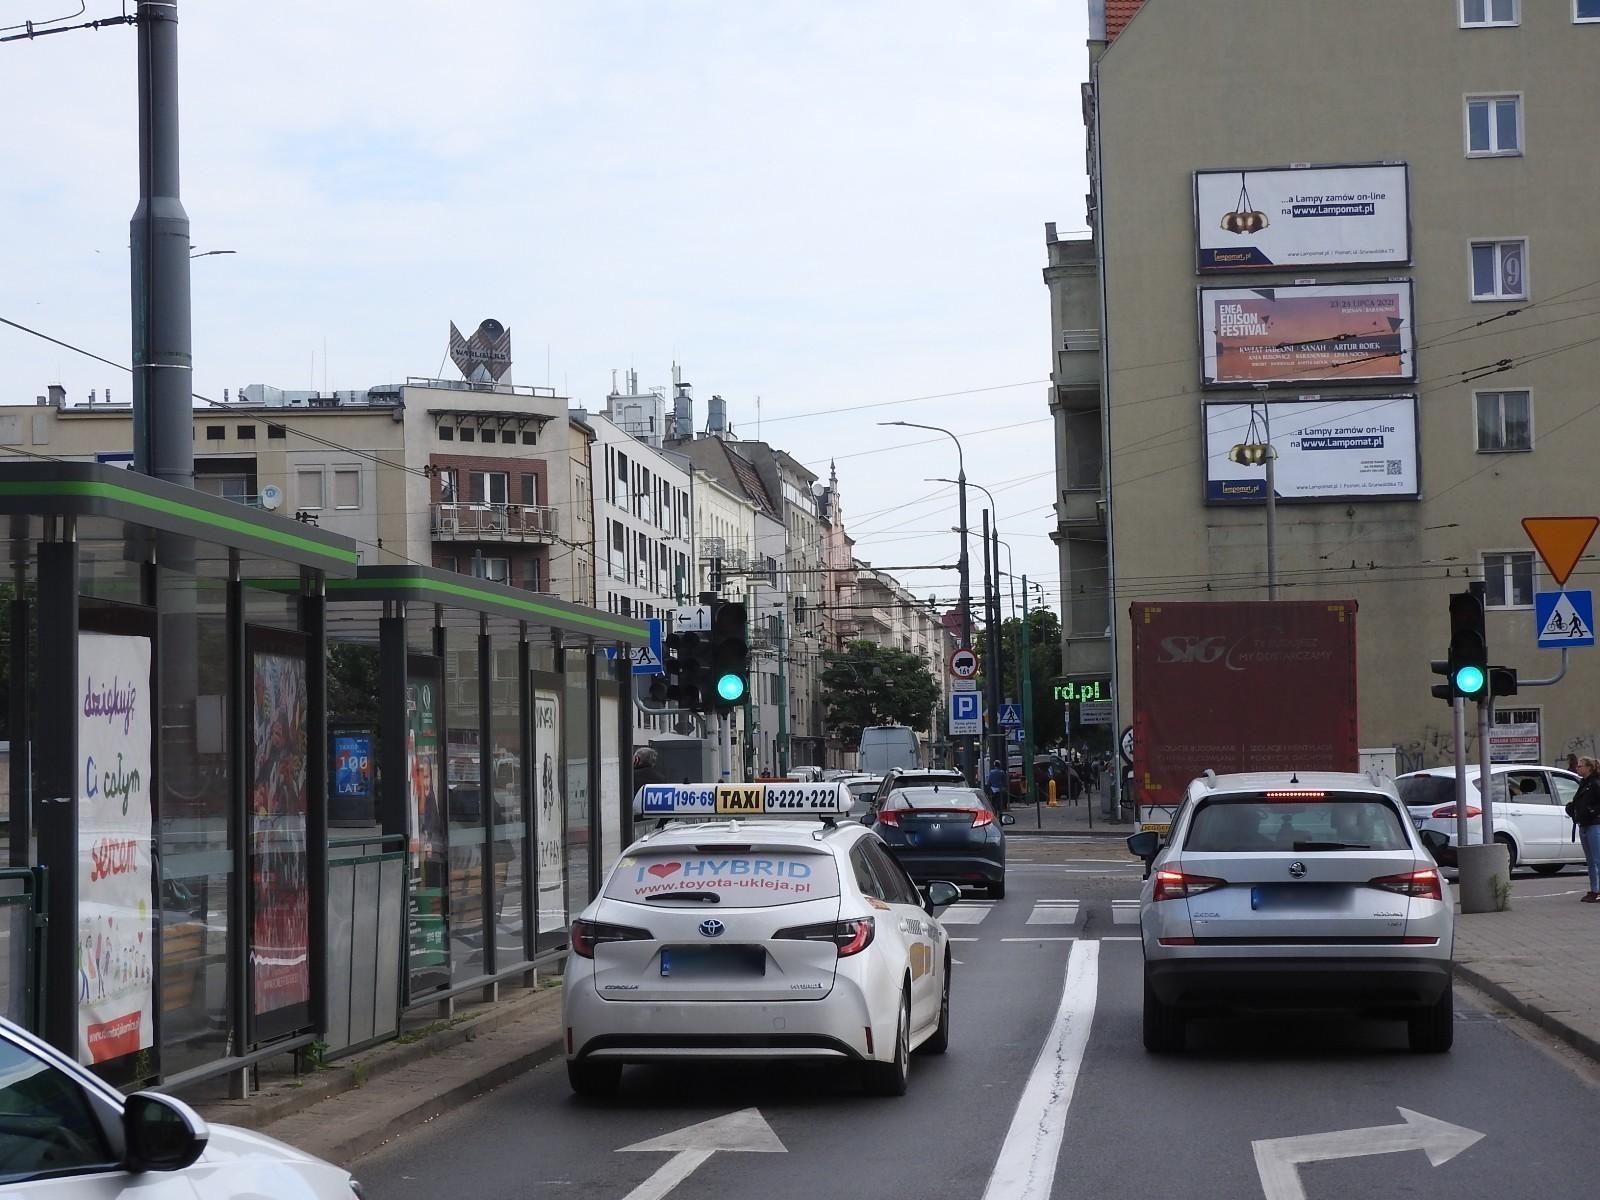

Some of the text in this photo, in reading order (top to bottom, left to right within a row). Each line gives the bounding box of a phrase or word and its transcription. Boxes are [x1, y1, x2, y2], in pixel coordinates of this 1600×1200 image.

[1295, 195, 1323, 204] Lampy
[1325, 193, 1355, 202] zamów
[1357, 192, 1386, 201] on-line
[1293, 204, 1374, 216] www.Lampomat.pl
[1220, 304, 1242, 314] ENEA
[1220, 313, 1258, 325] EDISON
[1221, 324, 1269, 337] FESTIVAL
[1301, 344, 1326, 352] SANAH
[1333, 343, 1357, 351] ARTUR
[1304, 428, 1332, 436] Lampy
[1334, 427, 1364, 435] zamów
[1365, 425, 1395, 433] on-line
[1302, 437, 1383, 449] www.Lampomat.pl
[1054, 682, 1099, 702] rd.pl
[84, 676, 136, 735] dziękuję
[958, 697, 973, 718] P
[86, 756, 99, 799] Ci
[647, 789, 835, 809] M1 196-69 TAXI 8-222-222
[637, 859, 812, 883] I HYBRID
[634, 877, 811, 896] www.toyota-ukleja.pl
